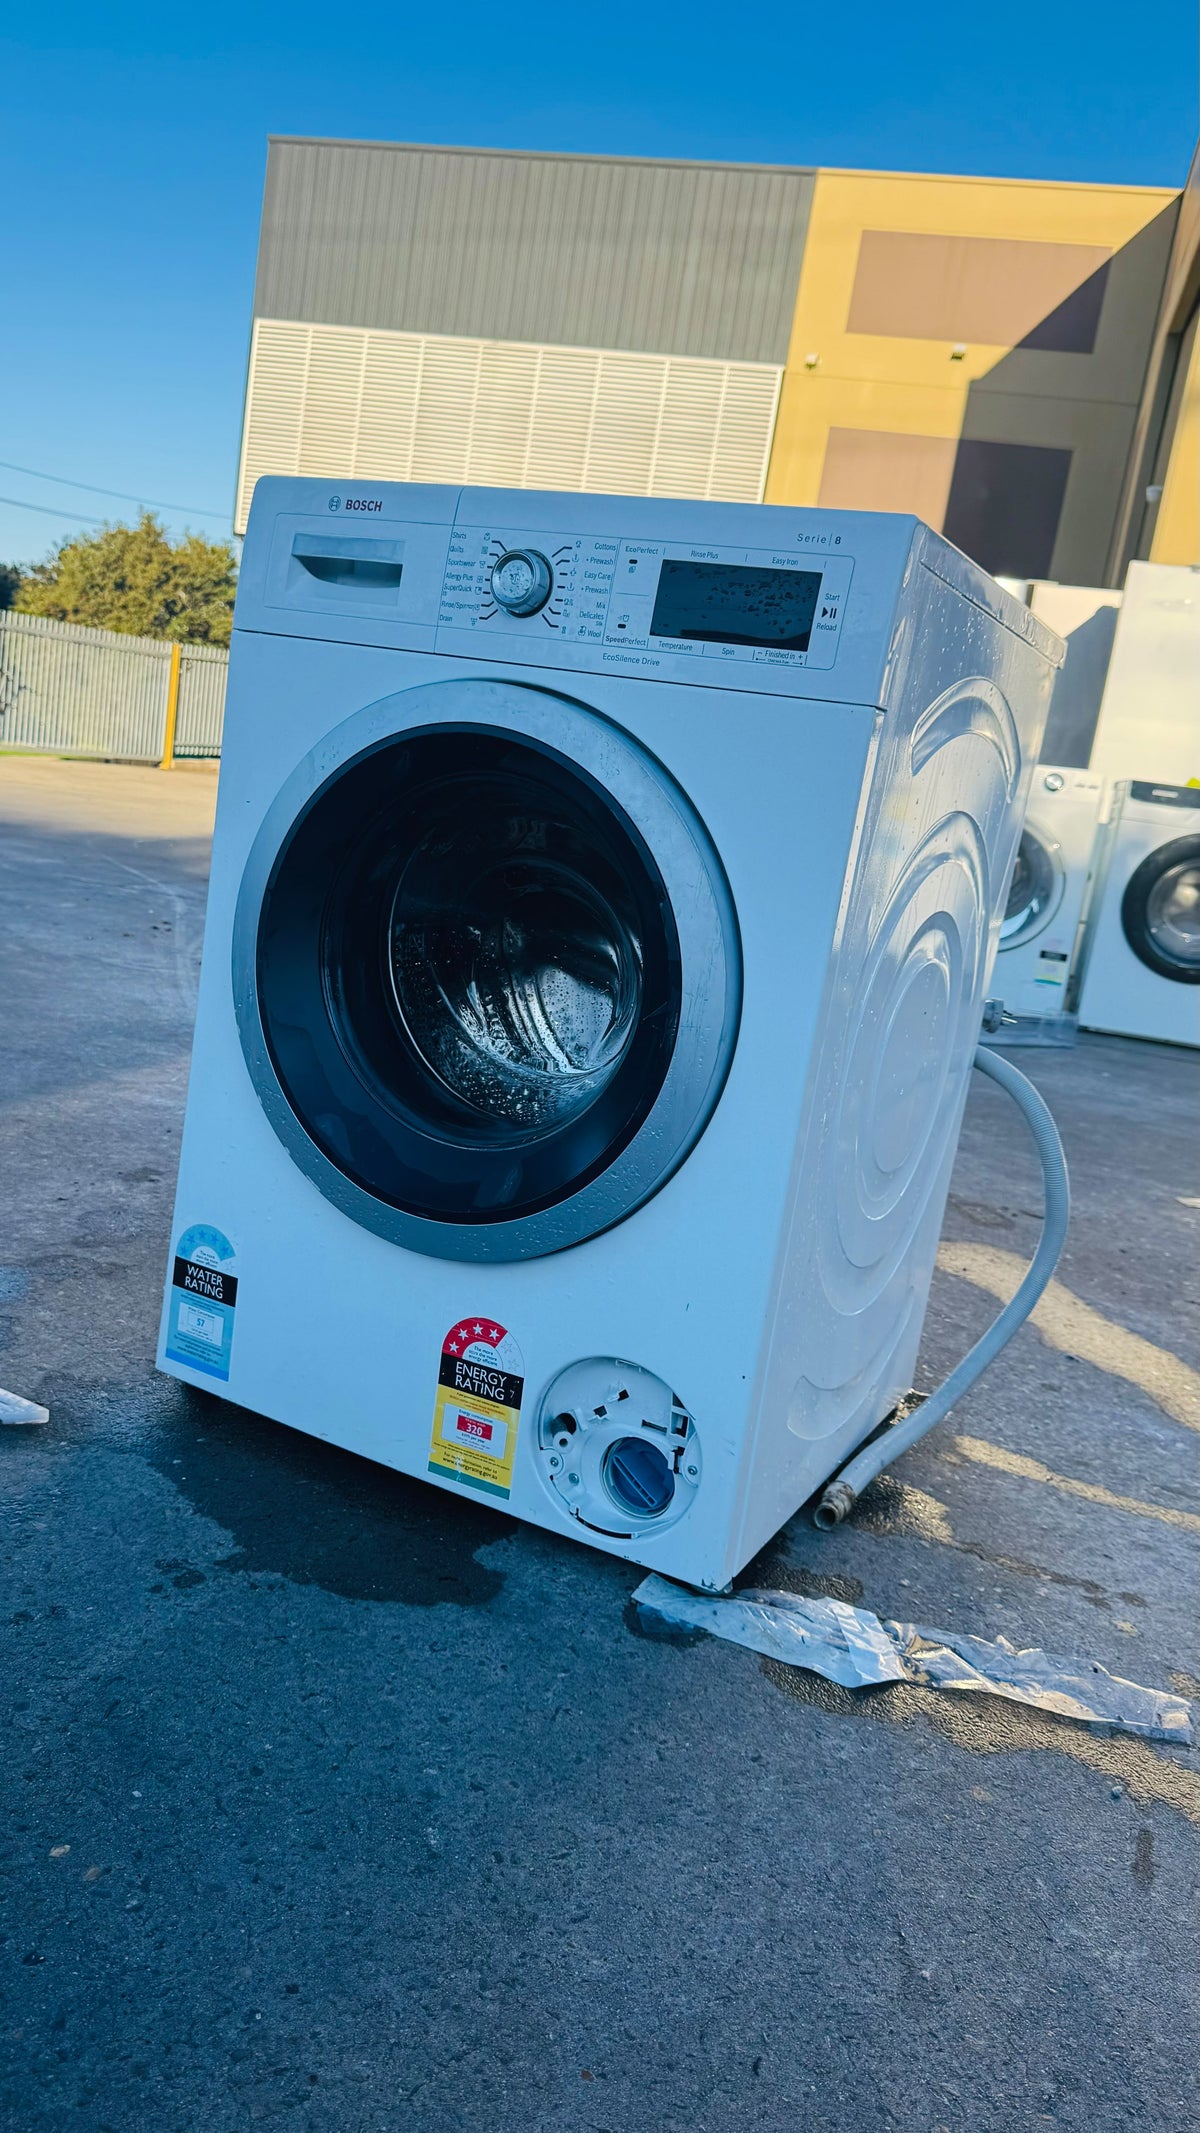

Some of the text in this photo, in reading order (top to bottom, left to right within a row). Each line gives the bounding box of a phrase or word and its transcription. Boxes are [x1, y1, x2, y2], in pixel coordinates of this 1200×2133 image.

[346, 499, 383, 512] BOSCH
[797, 533, 842, 545] Serie 8
[594, 542, 616, 551] Cottons
[625, 546, 658, 554] EcoPerfect
[691, 550, 719, 559] Rinse Plus
[448, 558, 476, 567] Sportswear
[590, 557, 614, 565] Prewash
[772, 557, 799, 566] Easy Iron
[584, 571, 611, 580] Easy Care
[585, 586, 609, 594] Prewash
[825, 593, 840, 601] Start
[440, 614, 452, 622] Drain
[580, 611, 604, 620] Delicates
[816, 622, 837, 631] Reload
[588, 630, 601, 638] Wool
[606, 635, 646, 646] SpeedPerfect
[659, 641, 693, 651] Temperature
[722, 647, 735, 655] Spin
[765, 650, 795, 660] Finished in
[602, 653, 660, 666] EcoSilence Drive
[187, 1264, 223, 1287] WATER
[185, 1276, 223, 1299] RATING
[196, 1318, 205, 1327] 57
[456, 1361, 507, 1387] ENERGY
[455, 1374, 505, 1400] RATING
[466, 1422, 483, 1436] 320
